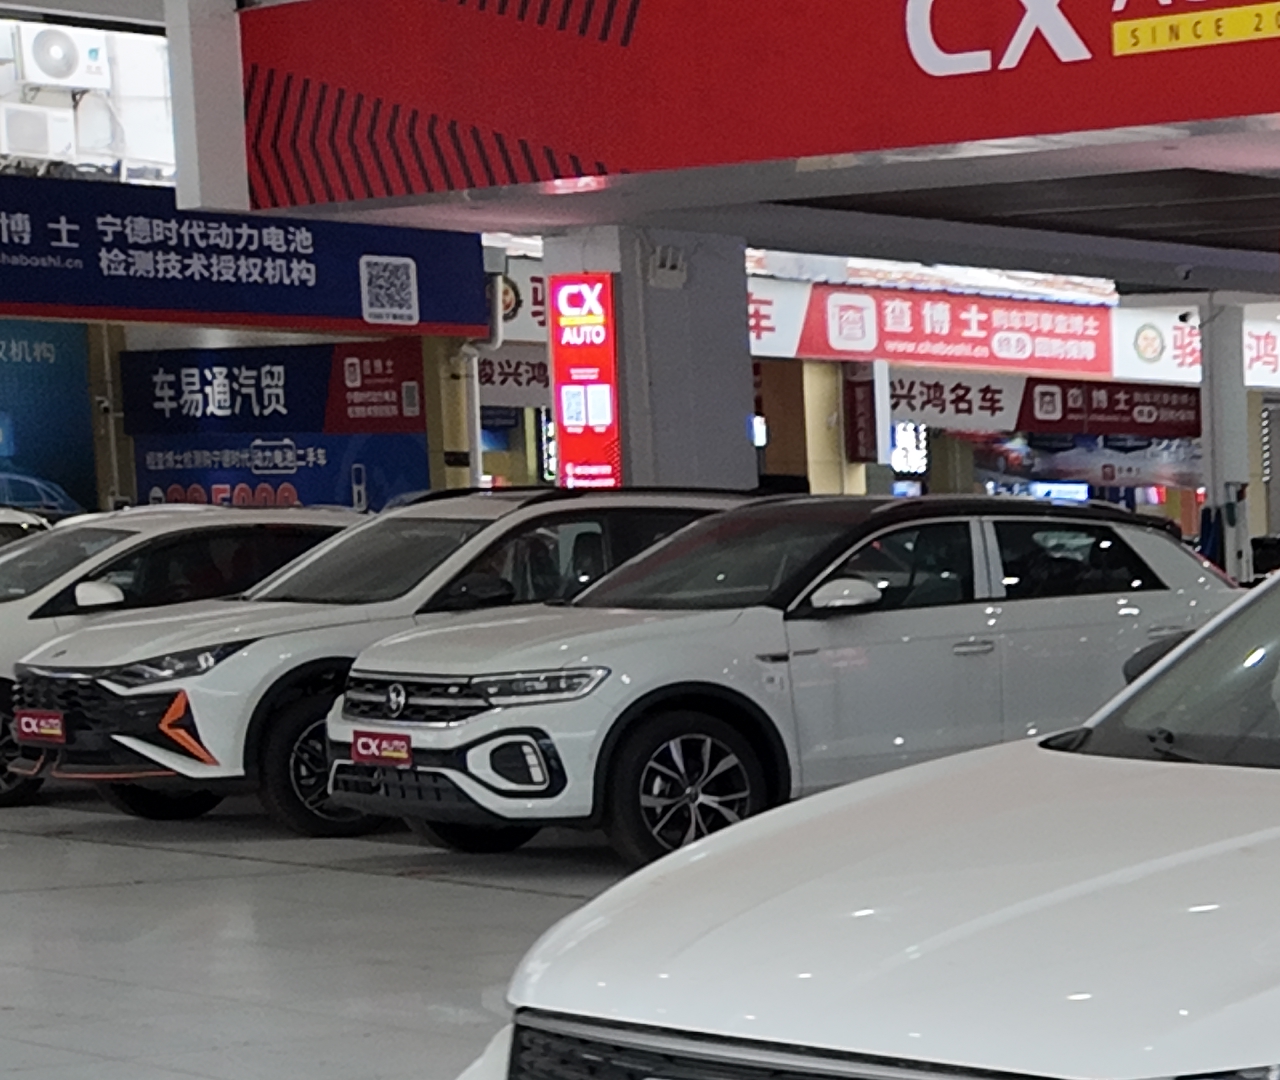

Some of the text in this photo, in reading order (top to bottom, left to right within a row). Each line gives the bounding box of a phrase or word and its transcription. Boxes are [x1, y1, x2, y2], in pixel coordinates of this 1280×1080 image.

[906, 0, 1092, 76] CX
[1130, 20, 1224, 47] SINCE
[96, 214, 315, 255] 宁德时代动力电池
[98, 247, 317, 287] 检测技术授权机构
[557, 283, 603, 317] CX
[883, 299, 989, 338] 查博士
[561, 326, 606, 345] AUTO
[152, 365, 288, 418] 车易通汽贸
[890, 378, 1005, 417] 兴鸿名车
[356, 736, 380, 756] CX
